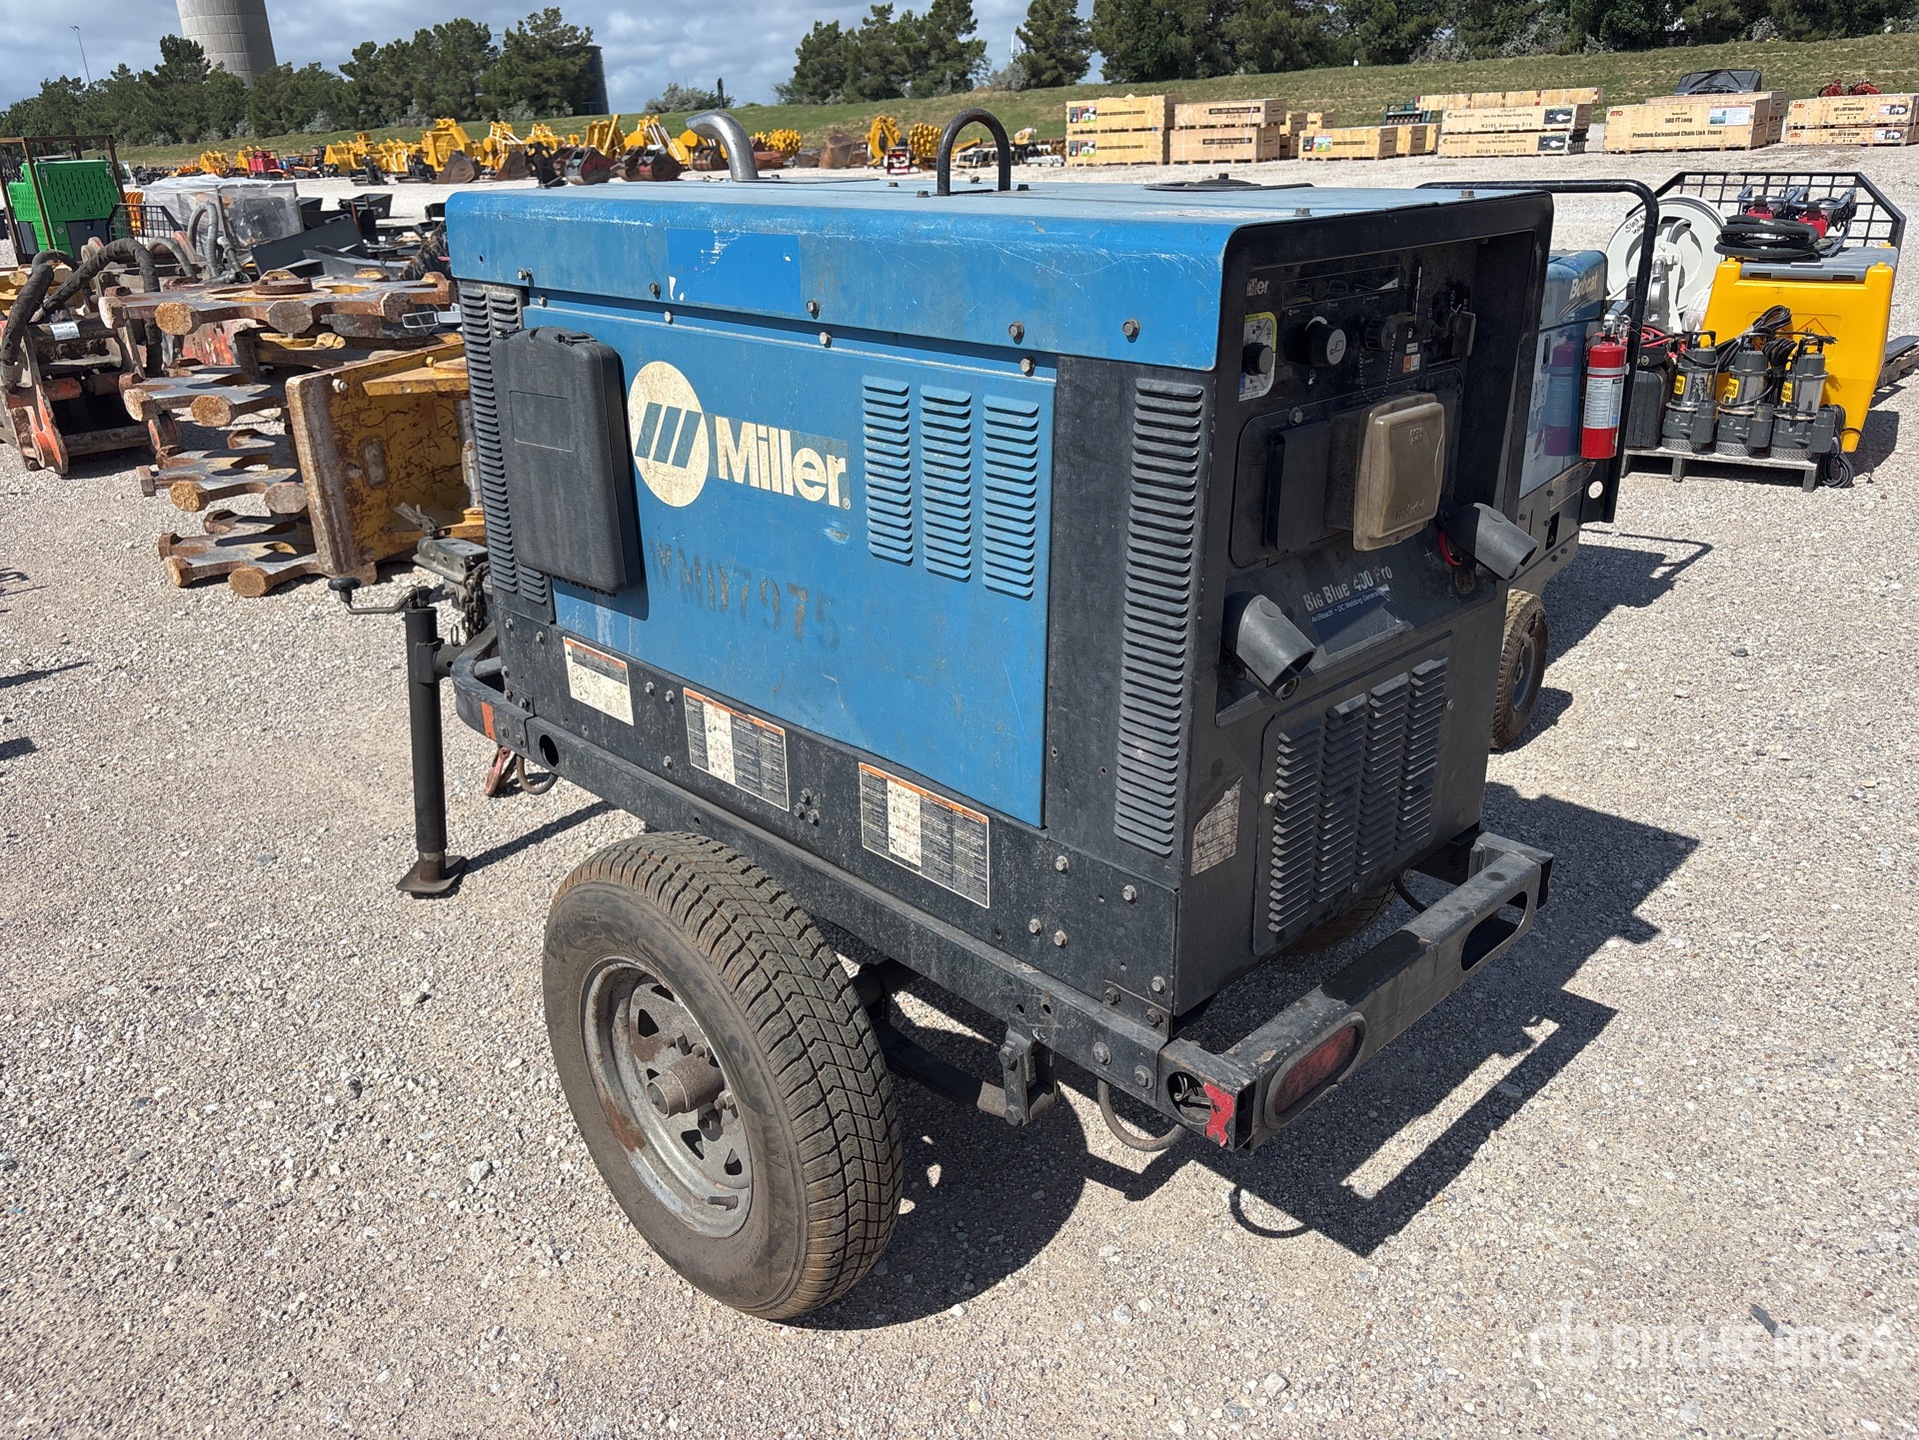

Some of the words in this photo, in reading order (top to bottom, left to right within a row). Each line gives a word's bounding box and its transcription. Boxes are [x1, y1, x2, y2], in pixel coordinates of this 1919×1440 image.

[1246, 277, 1269, 296] iller
[1569, 270, 1598, 300] Bobcat
[715, 416, 847, 508] Miller
[1322, 583, 1350, 604] Blue
[1353, 569, 1374, 591] 400
[1373, 566, 1393, 583] Pro
[1345, 597, 1364, 609] Welding
